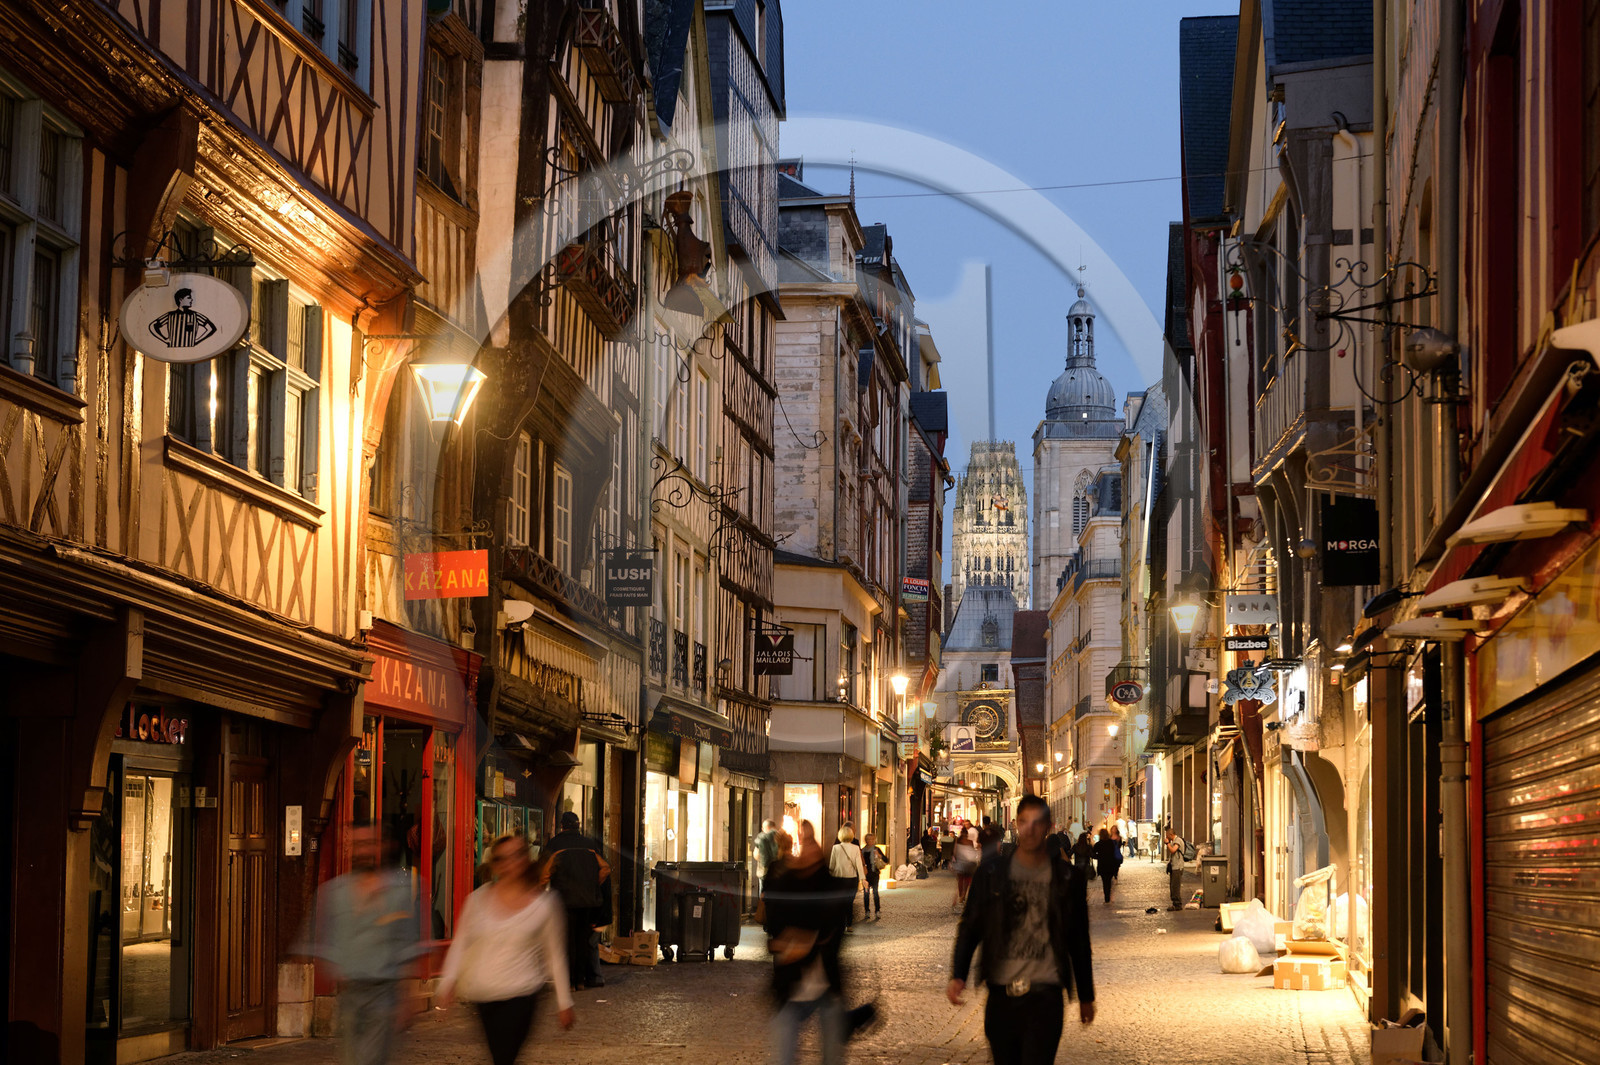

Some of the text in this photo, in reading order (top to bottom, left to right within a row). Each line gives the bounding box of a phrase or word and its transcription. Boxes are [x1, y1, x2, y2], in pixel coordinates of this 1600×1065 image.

[1327, 540, 1379, 551] MORGA
[404, 568, 489, 591] KAZANA
[608, 568, 651, 580] LUSH
[903, 584, 927, 592] FONCIA
[1227, 640, 1268, 649] Bizzbee
[380, 655, 448, 709] KAZANA
[1116, 687, 1138, 699] C&A
[129, 701, 188, 745] Locker
